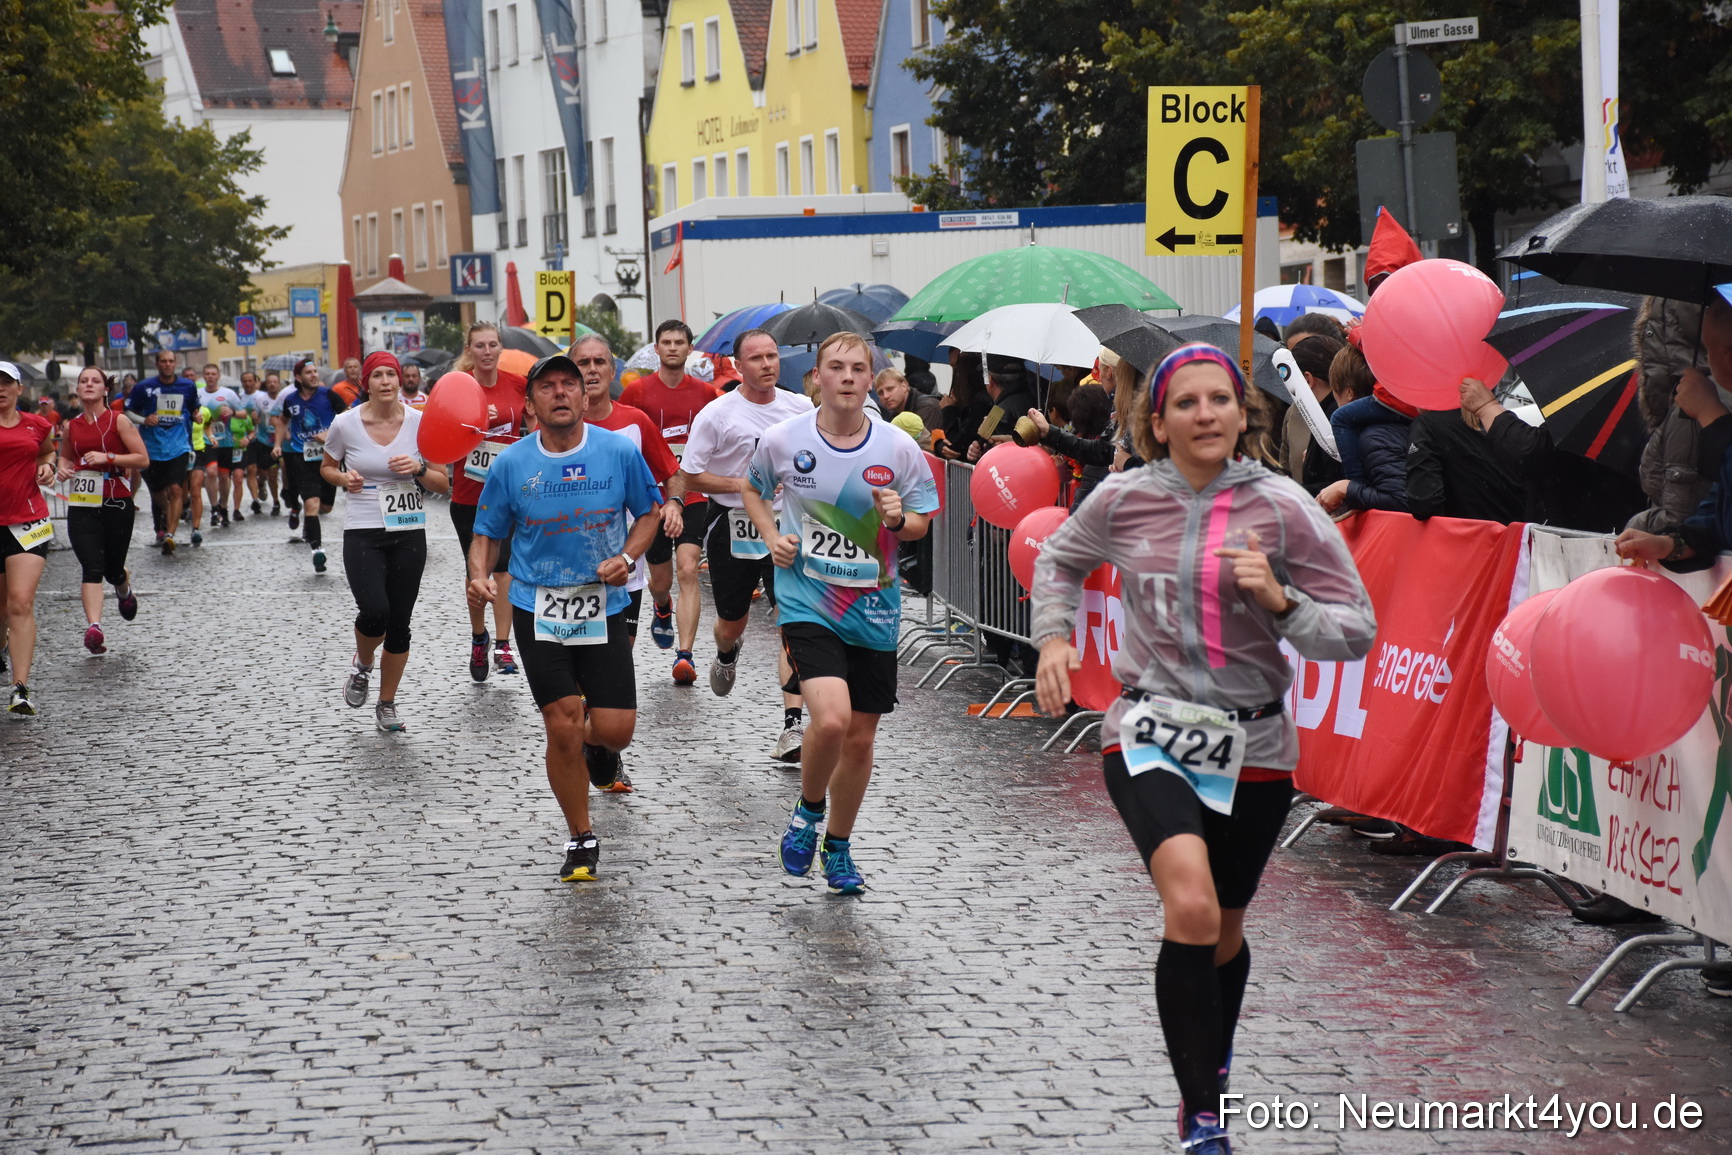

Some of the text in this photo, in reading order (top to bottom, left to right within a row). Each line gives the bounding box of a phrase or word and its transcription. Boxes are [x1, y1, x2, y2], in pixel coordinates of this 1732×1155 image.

[1410, 24, 1474, 39] Ulmer Gasse
[454, 57, 487, 130] K&L
[1161, 94, 1246, 123] Block
[697, 116, 724, 147] HOTEL
[1174, 136, 1230, 220] C
[540, 273, 570, 285] Block
[546, 291, 565, 322] D
[238, 336, 255, 344] TAXI
[165, 400, 176, 410] 10
[793, 475, 817, 485] PARTL
[867, 470, 891, 481] Hervis
[74, 479, 95, 493] 230
[543, 476, 614, 494] firmenlauf
[793, 482, 817, 490] Neumarkt
[989, 465, 1018, 509] RÖDL
[570, 490, 600, 498] sulzbach
[385, 492, 423, 513] 2408
[397, 516, 419, 525] Bianka
[30, 527, 51, 540] Martin
[824, 562, 859, 577] Tobias
[543, 593, 601, 620] 2723
[863, 596, 882, 608] 17.
[865, 616, 895, 625] Stadtlauf
[1492, 621, 1526, 672] ÖDL
[1135, 716, 1234, 770] 2724
